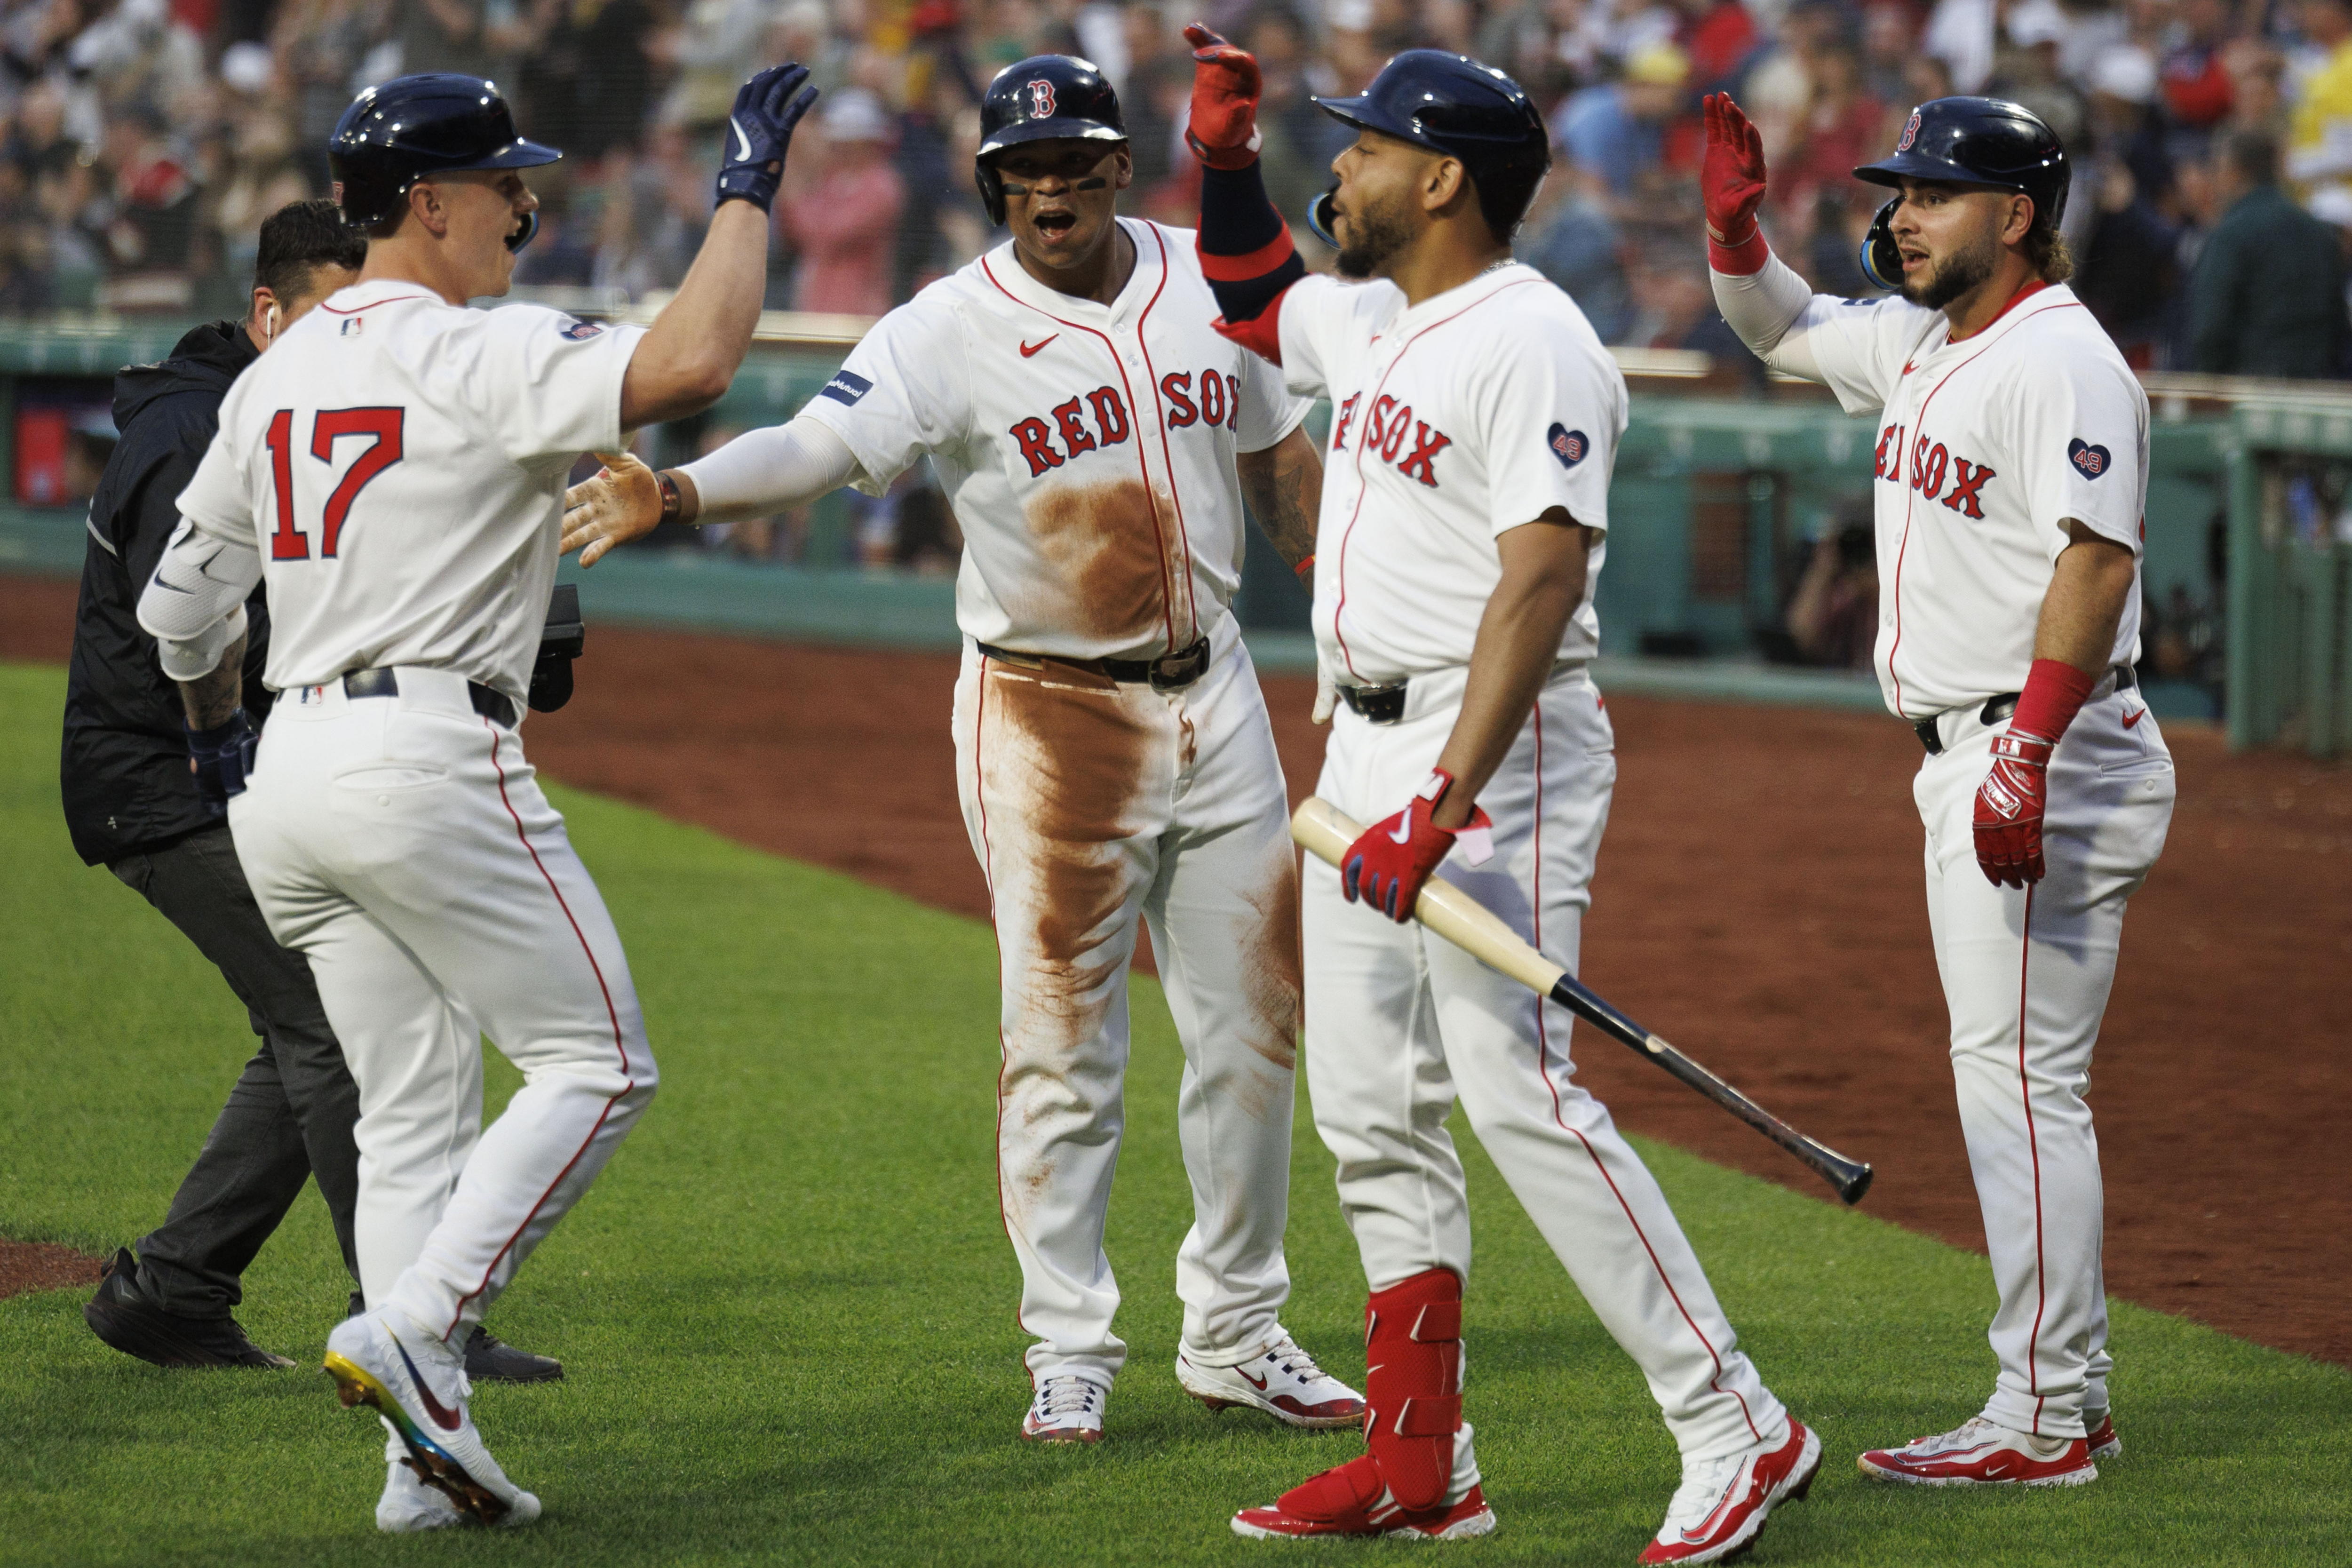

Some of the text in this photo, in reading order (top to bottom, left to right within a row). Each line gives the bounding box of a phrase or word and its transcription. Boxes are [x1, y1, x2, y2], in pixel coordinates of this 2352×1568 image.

[1027, 80, 1057, 119] B
[1009, 386, 1129, 478] RED
[1368, 394, 1453, 488] SOX
[1553, 434, 1581, 461] 49
[2074, 449, 2102, 473] 49
[266, 406, 405, 562] 17
[1912, 433, 1996, 520] SOX
